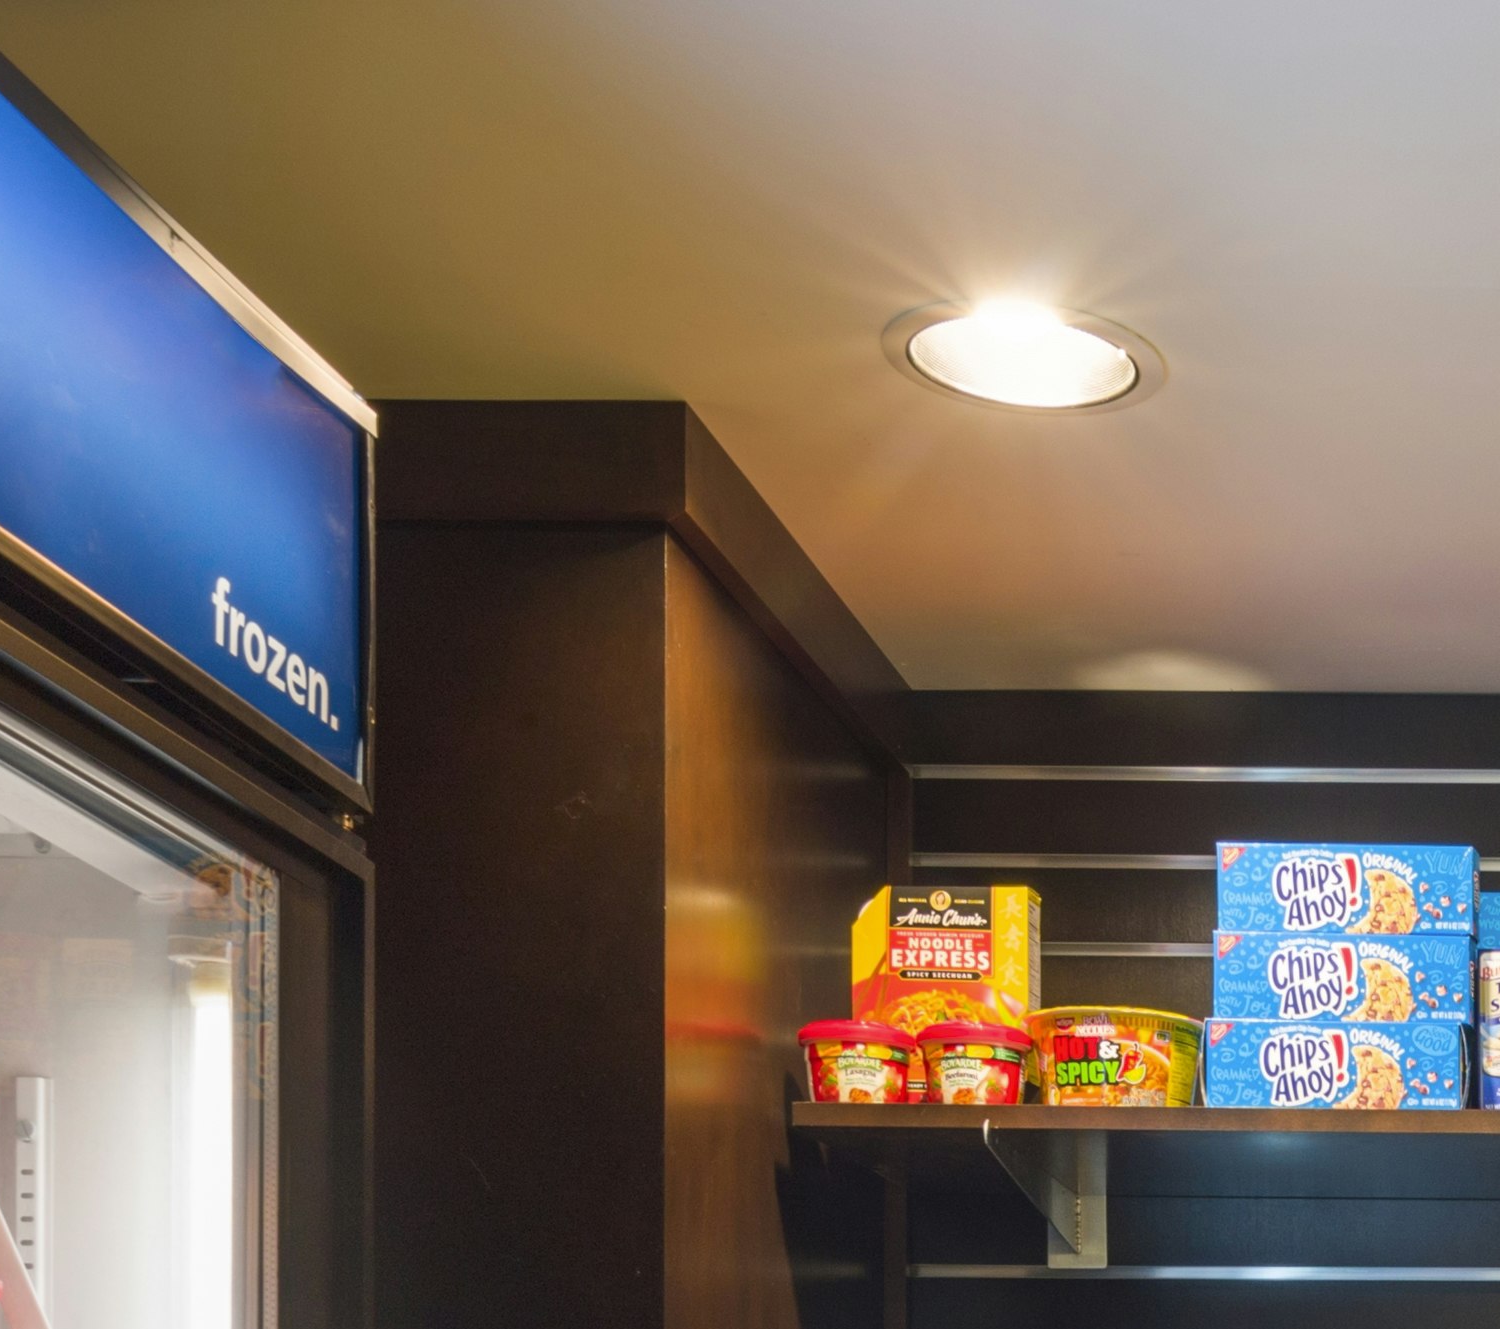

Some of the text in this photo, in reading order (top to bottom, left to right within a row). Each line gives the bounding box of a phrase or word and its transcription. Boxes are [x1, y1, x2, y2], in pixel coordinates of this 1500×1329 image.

[212, 576, 339, 731] frozen.
[1276, 861, 1343, 901] Chips
[1362, 852, 1417, 884] ORIGINAL
[893, 908, 941, 926] Annie
[908, 938, 973, 950] NOODLE
[1359, 942, 1413, 973] ORIGINAL
[892, 949, 989, 970] EXPRESS
[1272, 950, 1338, 990] Chips
[1054, 1035, 1118, 1060] HOT &
[1263, 1037, 1330, 1077] Chips
[1350, 1029, 1405, 1059] ORIGINAL
[1056, 1060, 1119, 1085] SPICY
